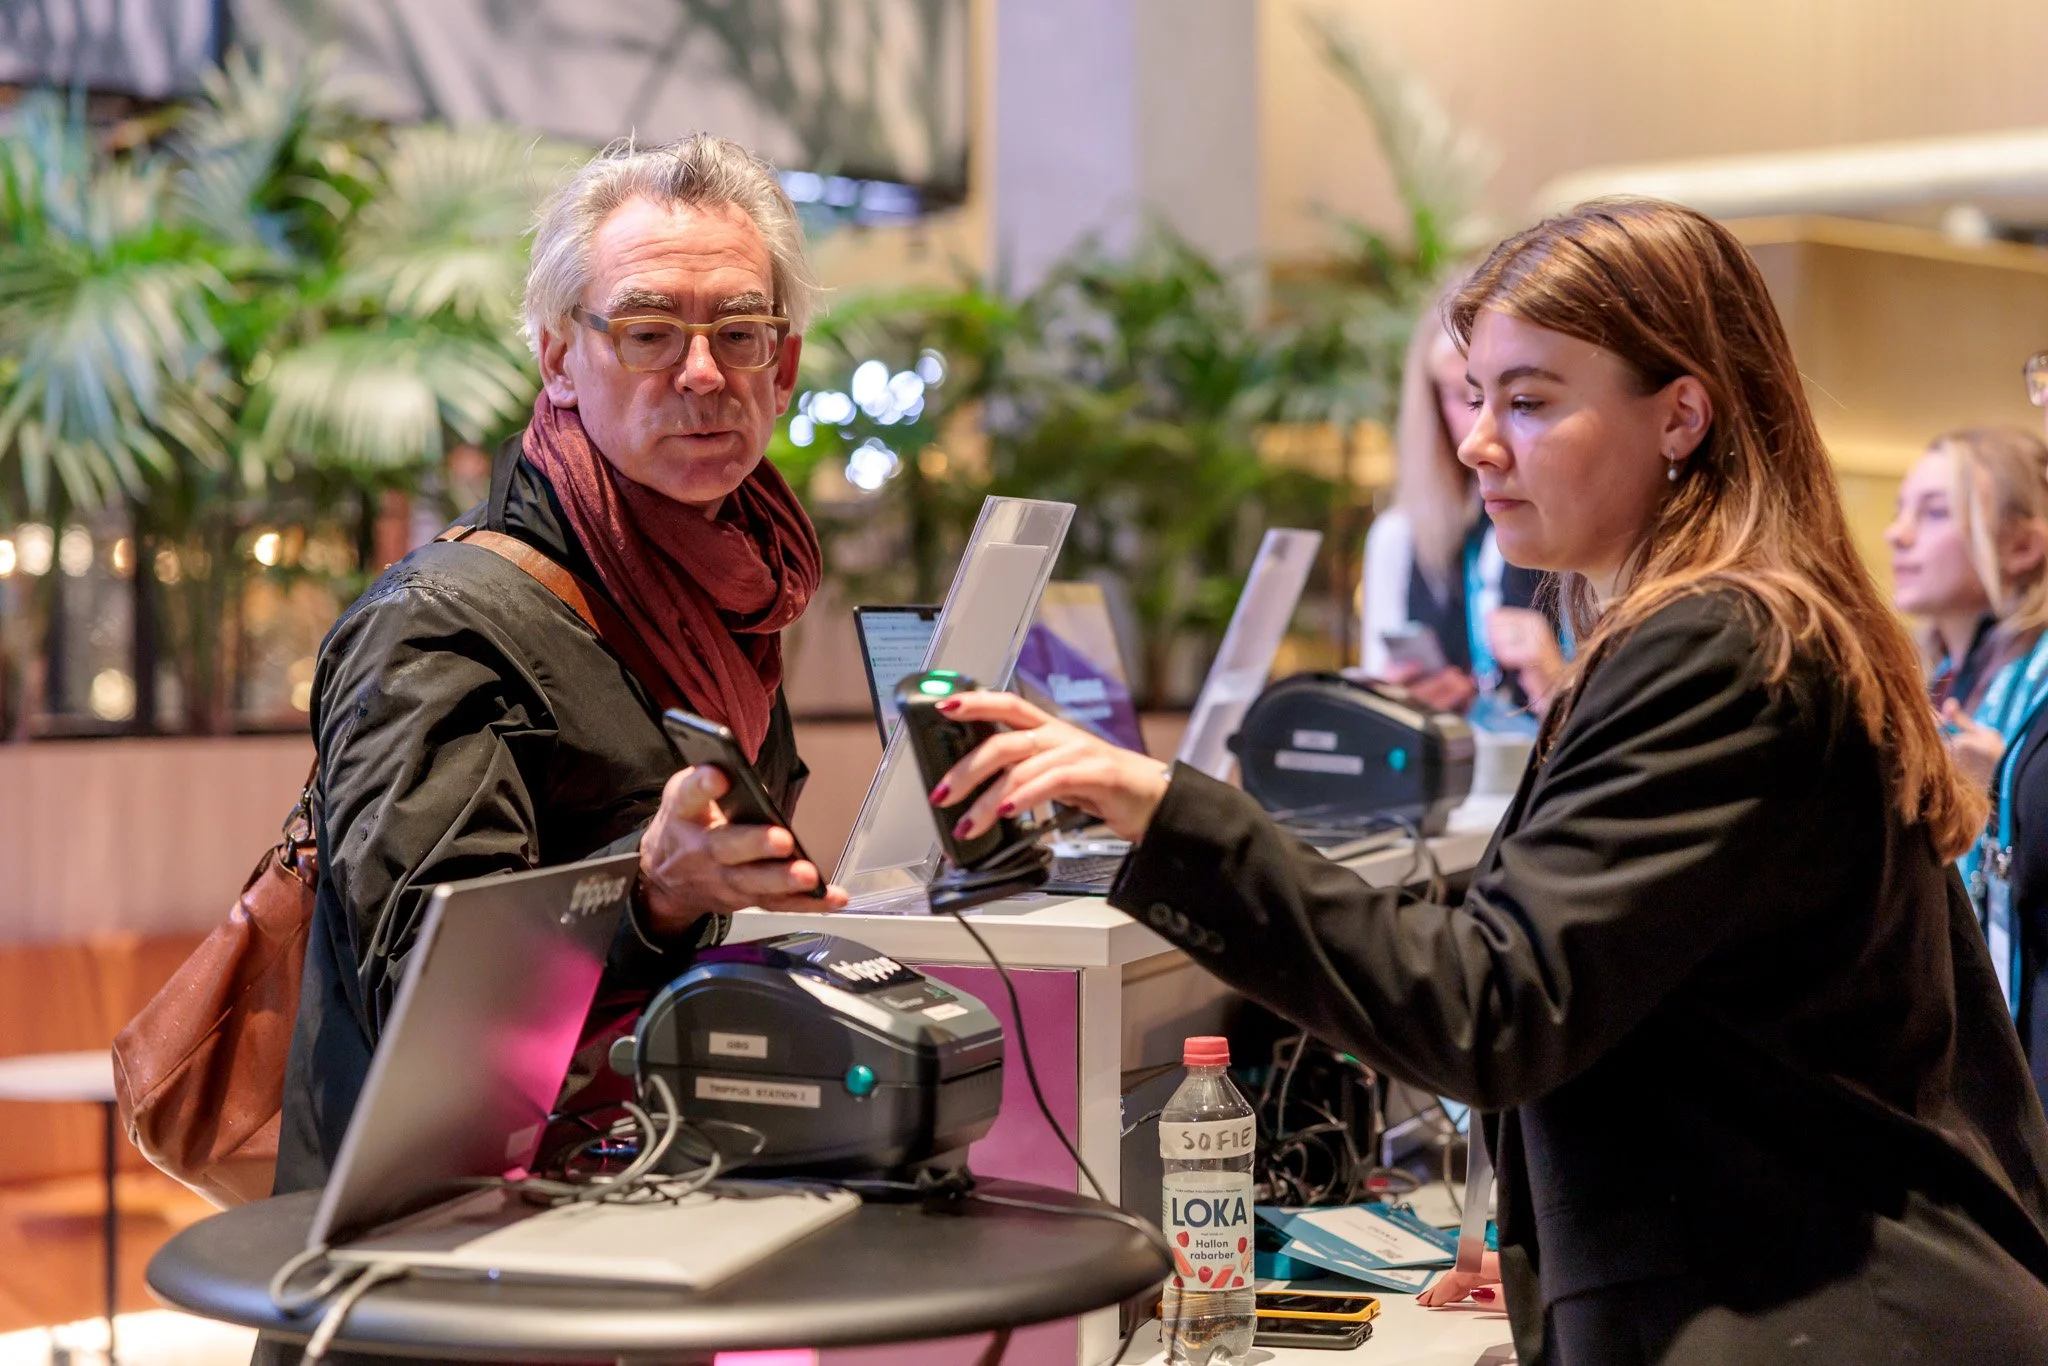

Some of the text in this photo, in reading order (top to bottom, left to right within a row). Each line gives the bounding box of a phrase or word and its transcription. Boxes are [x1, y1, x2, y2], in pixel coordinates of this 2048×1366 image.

[828, 956, 902, 983] trippus
[1181, 1126, 1252, 1151] SOFIE
[1172, 1196, 1248, 1228] LOKA
[1190, 1251, 1235, 1260] rabarber
[1195, 1239, 1229, 1249] Hallon
